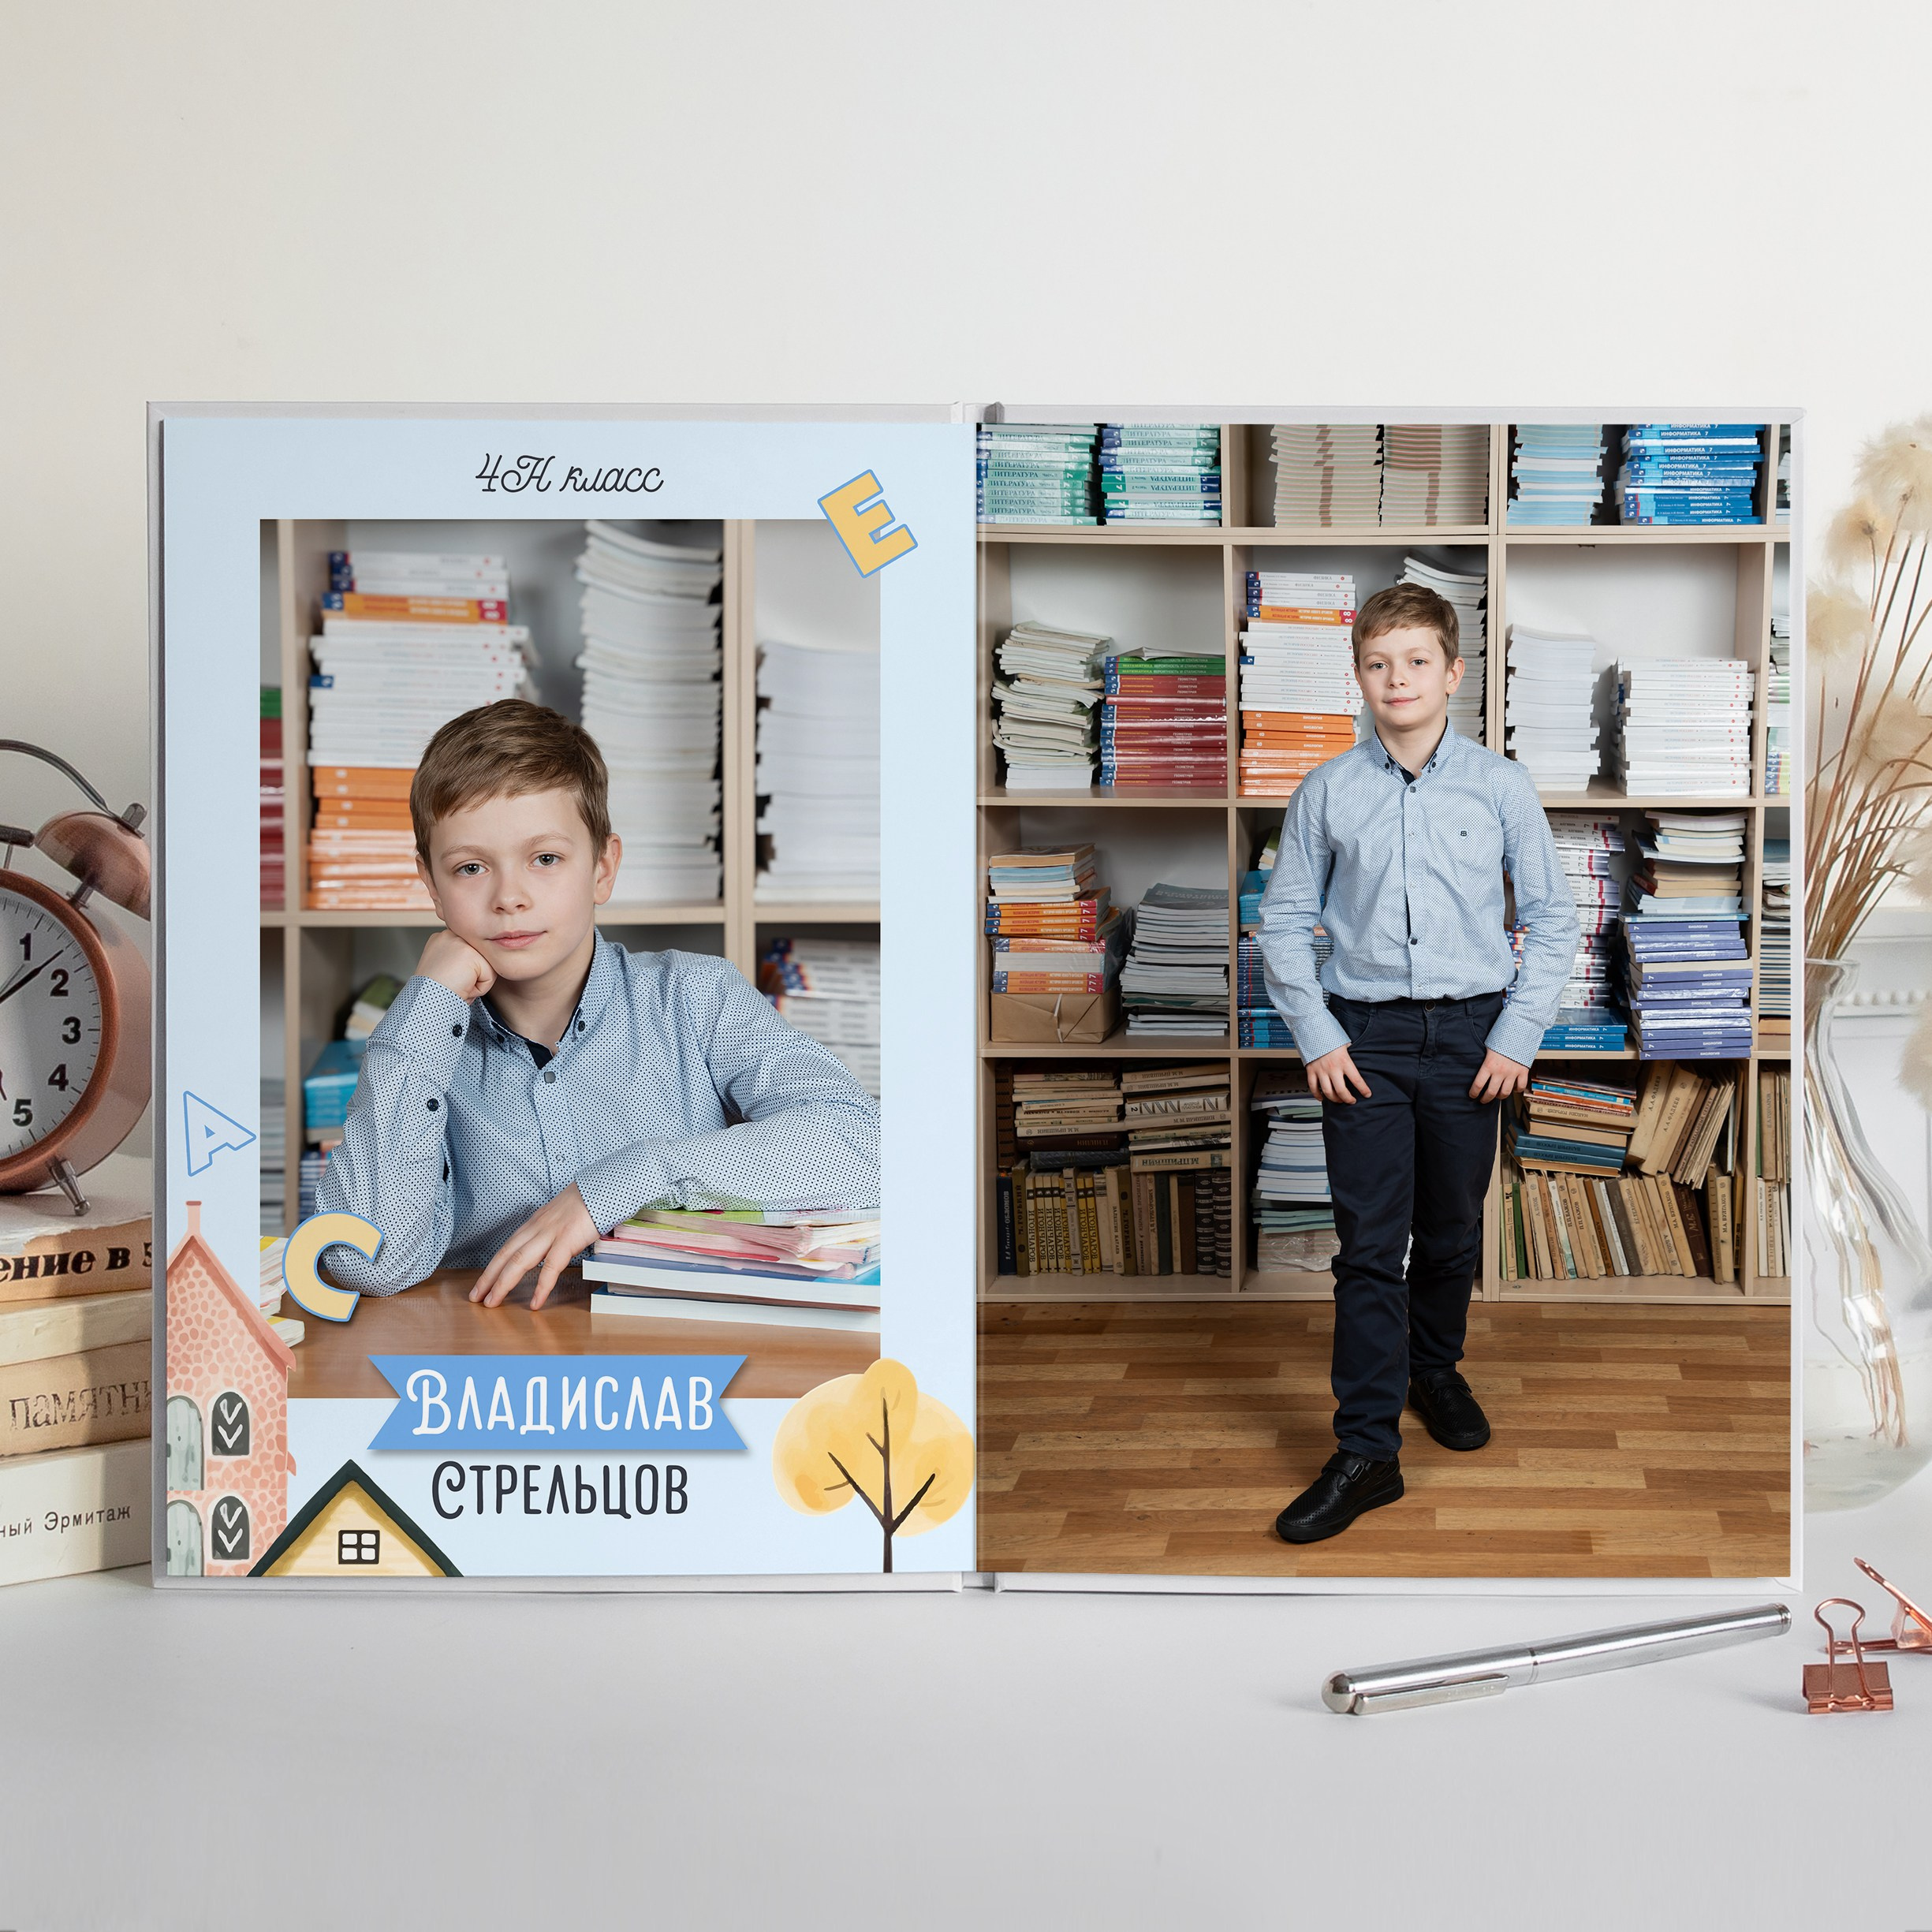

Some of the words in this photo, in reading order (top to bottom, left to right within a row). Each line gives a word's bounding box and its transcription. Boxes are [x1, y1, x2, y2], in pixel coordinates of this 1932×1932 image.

[476, 453, 555, 493] 4Н
[560, 465, 664, 493] класс
[20, 933, 31, 960] 1
[50, 969, 69, 997] 2
[62, 1017, 81, 1044] 3
[48, 1064, 69, 1091] 4
[13, 1099, 32, 1126] 5
[105, 1248, 130, 1270] в
[406, 1369, 714, 1435] ВЛАДИСЛАВ
[432, 1460, 688, 1520] СТРЕЛЬЦОВ
[44, 1505, 130, 1533] Эрмитаж
